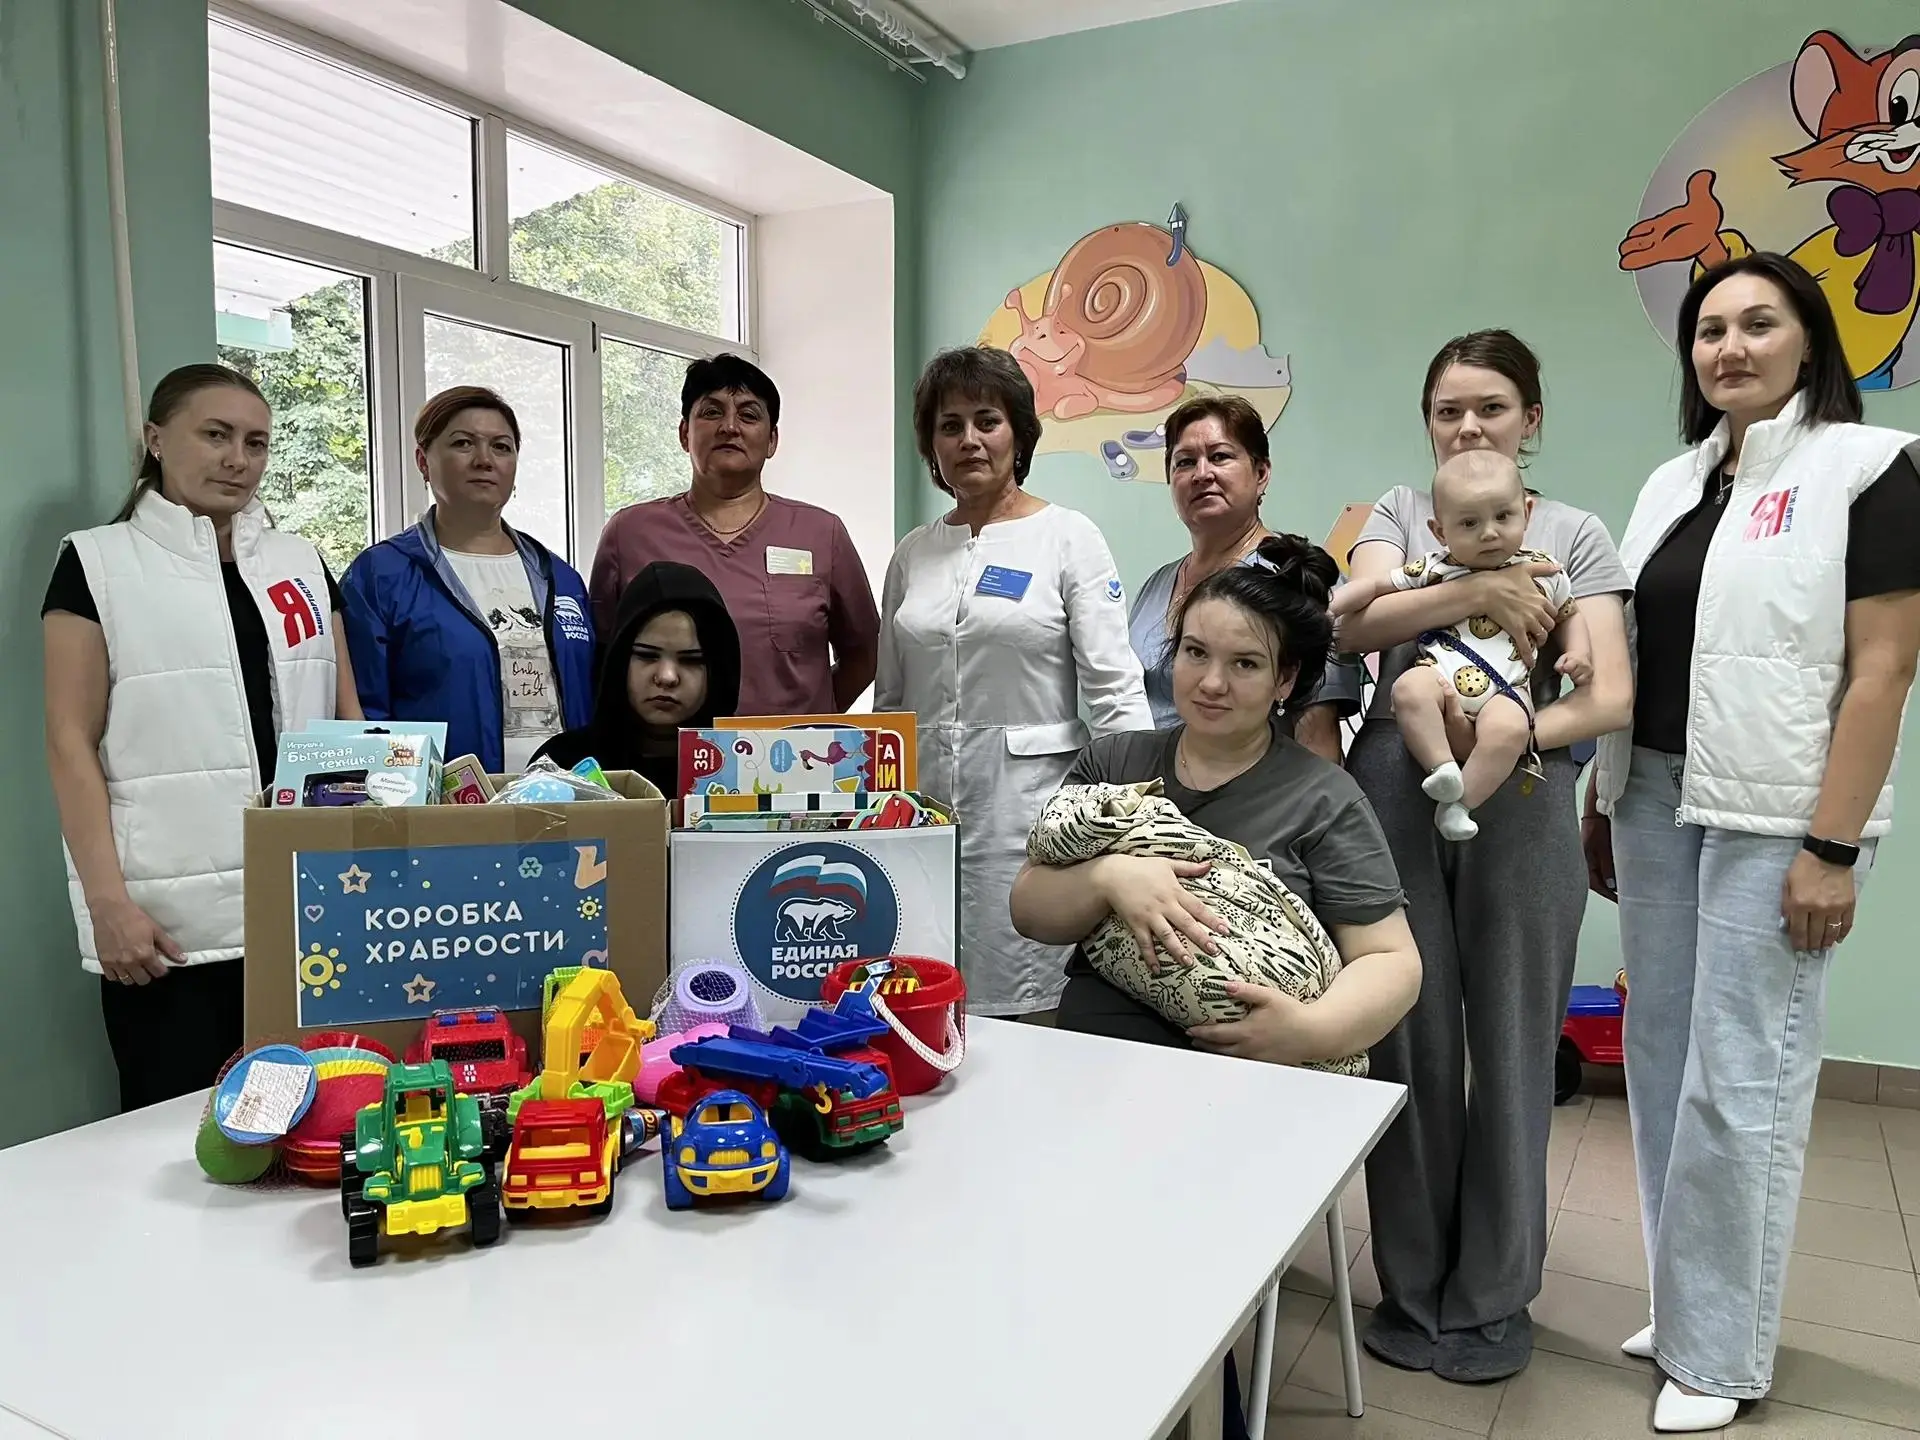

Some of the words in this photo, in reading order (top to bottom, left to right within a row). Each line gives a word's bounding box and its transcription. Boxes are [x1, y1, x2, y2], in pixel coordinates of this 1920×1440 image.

[1743, 489, 1791, 540] Я
[267, 580, 317, 648] Я
[294, 578, 324, 635] БАШКОРТОСТАН
[286, 741, 324, 749] Игрушка
[383, 756, 423, 768] GAME
[693, 748, 709, 771] 35
[365, 900, 523, 931] КОРОБКА
[365, 929, 565, 964] ХРАБРОСТИ
[771, 944, 859, 962] ЕДИНАЯ
[771, 962, 834, 980] РОСС
